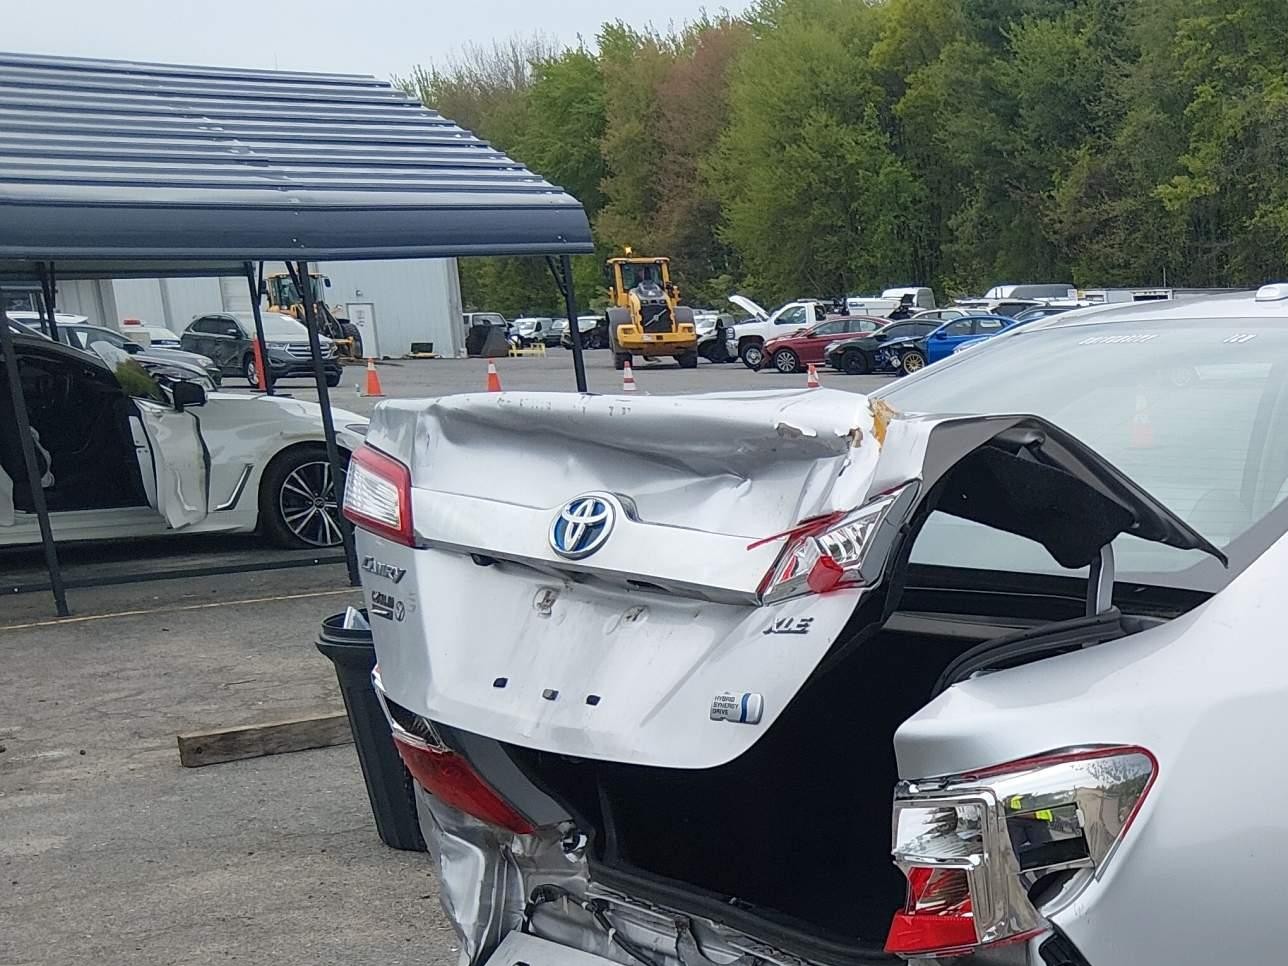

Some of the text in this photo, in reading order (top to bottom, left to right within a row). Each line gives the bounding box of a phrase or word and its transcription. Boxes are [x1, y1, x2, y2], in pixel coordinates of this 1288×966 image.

[762, 617, 814, 635] XLE
[713, 701, 739, 710] SYNERGY
[712, 708, 729, 716] DRIVE
